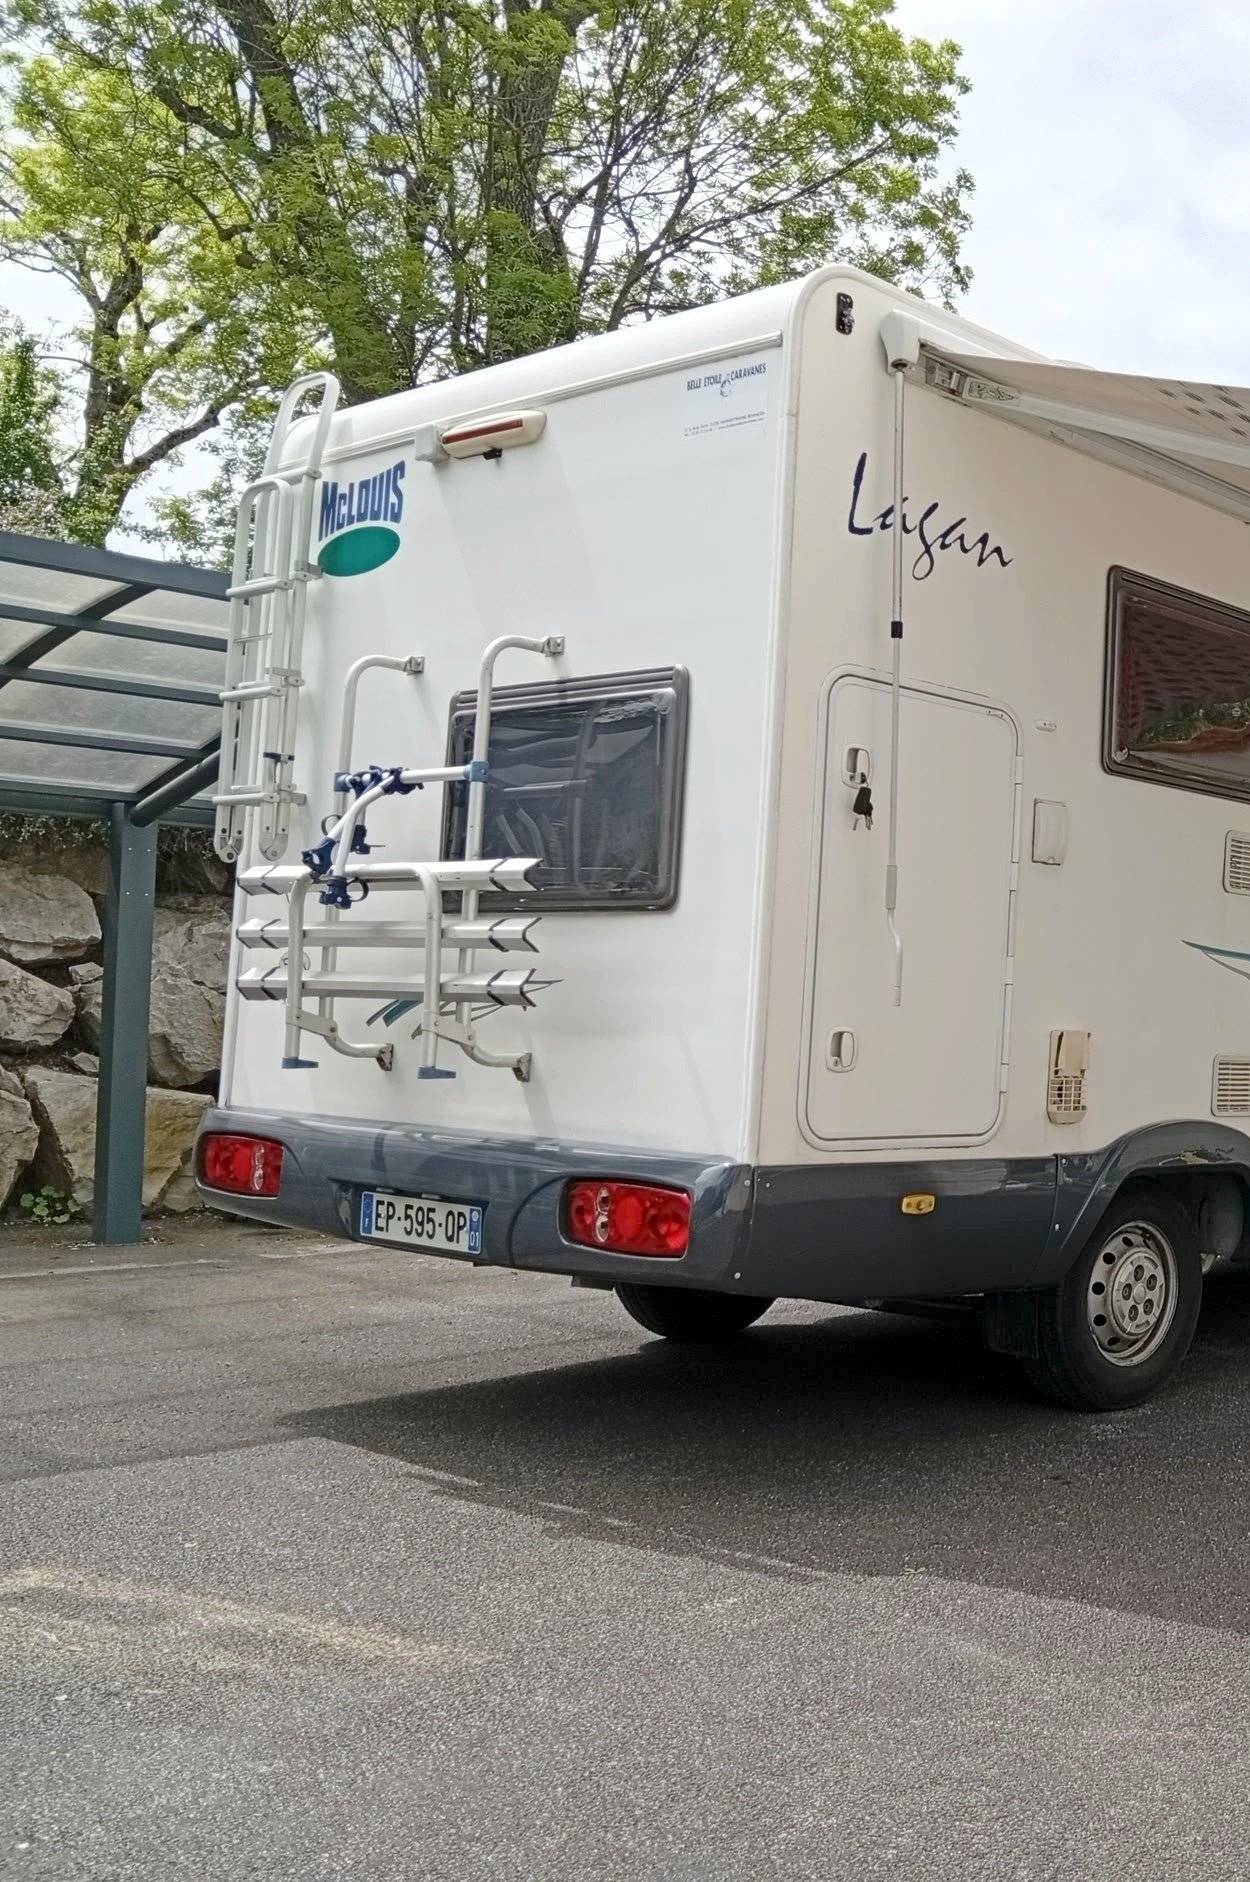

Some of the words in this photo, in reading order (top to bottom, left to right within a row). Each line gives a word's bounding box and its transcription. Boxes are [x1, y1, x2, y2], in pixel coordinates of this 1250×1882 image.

[686, 378, 702, 391] BELLE
[703, 374, 722, 387] ETOILE
[730, 363, 767, 381] CARAVANES
[848, 452, 1015, 581] Lagan
[469, 1231, 480, 1248] 01
